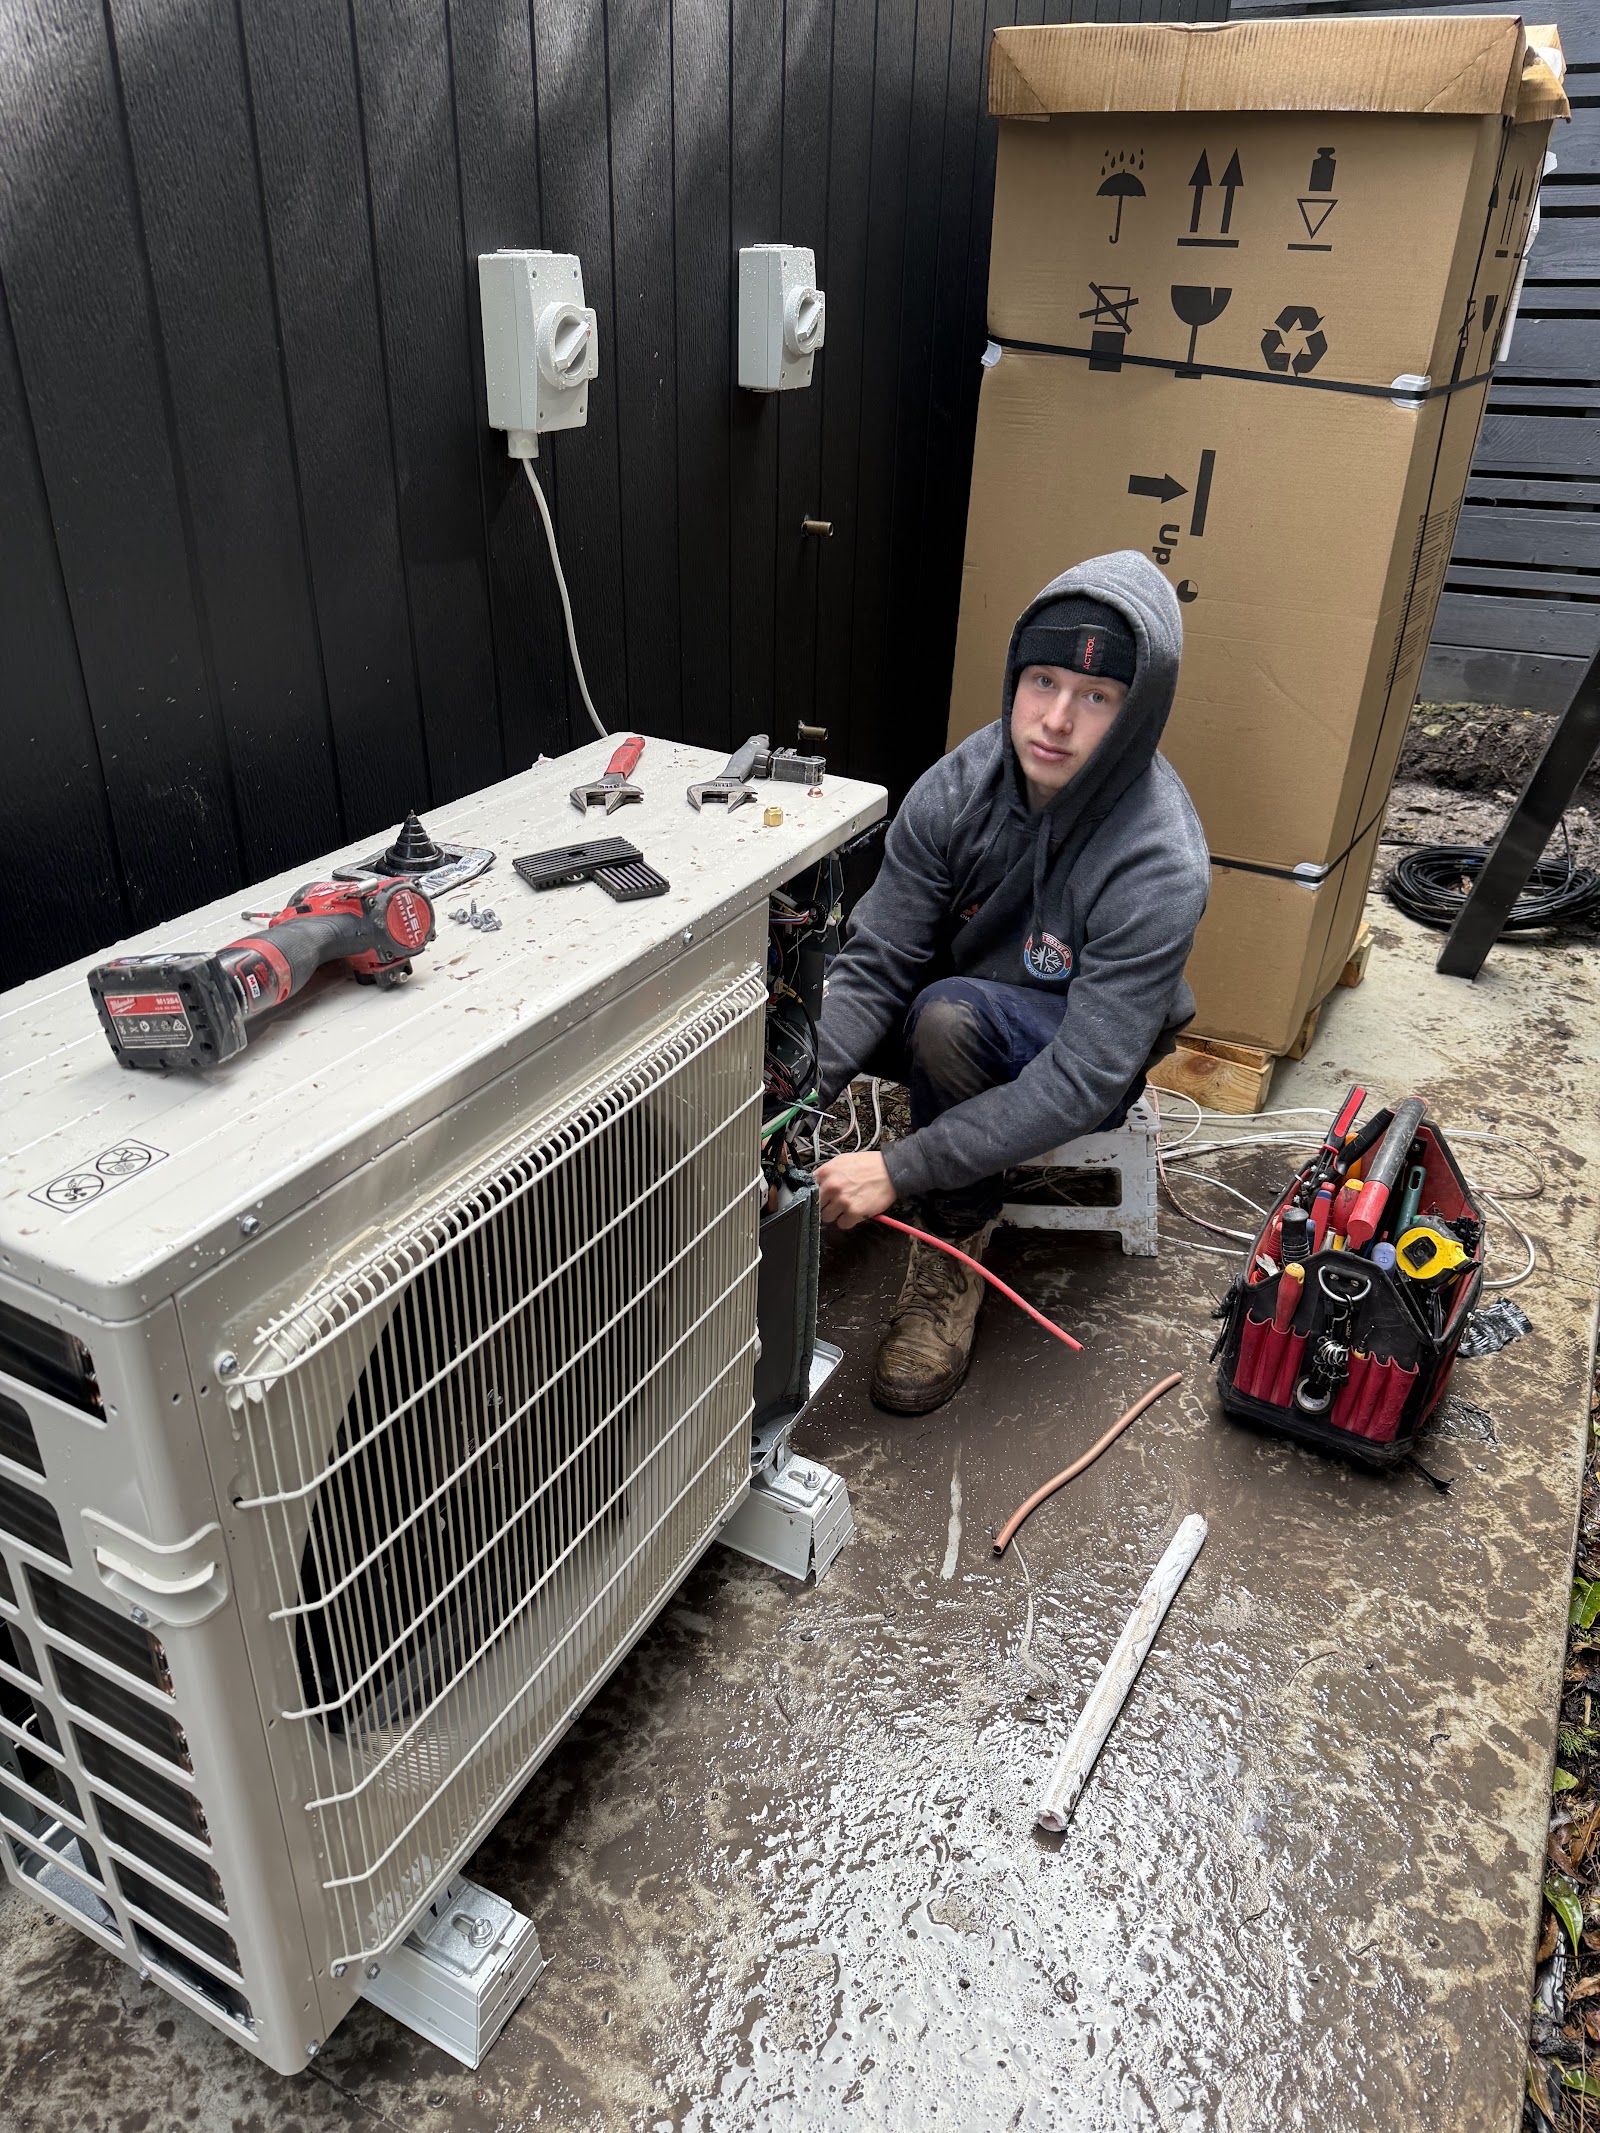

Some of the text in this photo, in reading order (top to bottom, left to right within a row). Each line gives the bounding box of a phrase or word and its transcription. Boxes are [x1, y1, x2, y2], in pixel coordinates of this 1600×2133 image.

[1152, 524, 1180, 565] Up
[1083, 636, 1096, 670] ACTROL
[396, 895, 415, 945] BRUSHLESS
[401, 893, 422, 942] FUEL
[1045, 937, 1065, 951] COAST
[249, 976, 260, 996] M12
